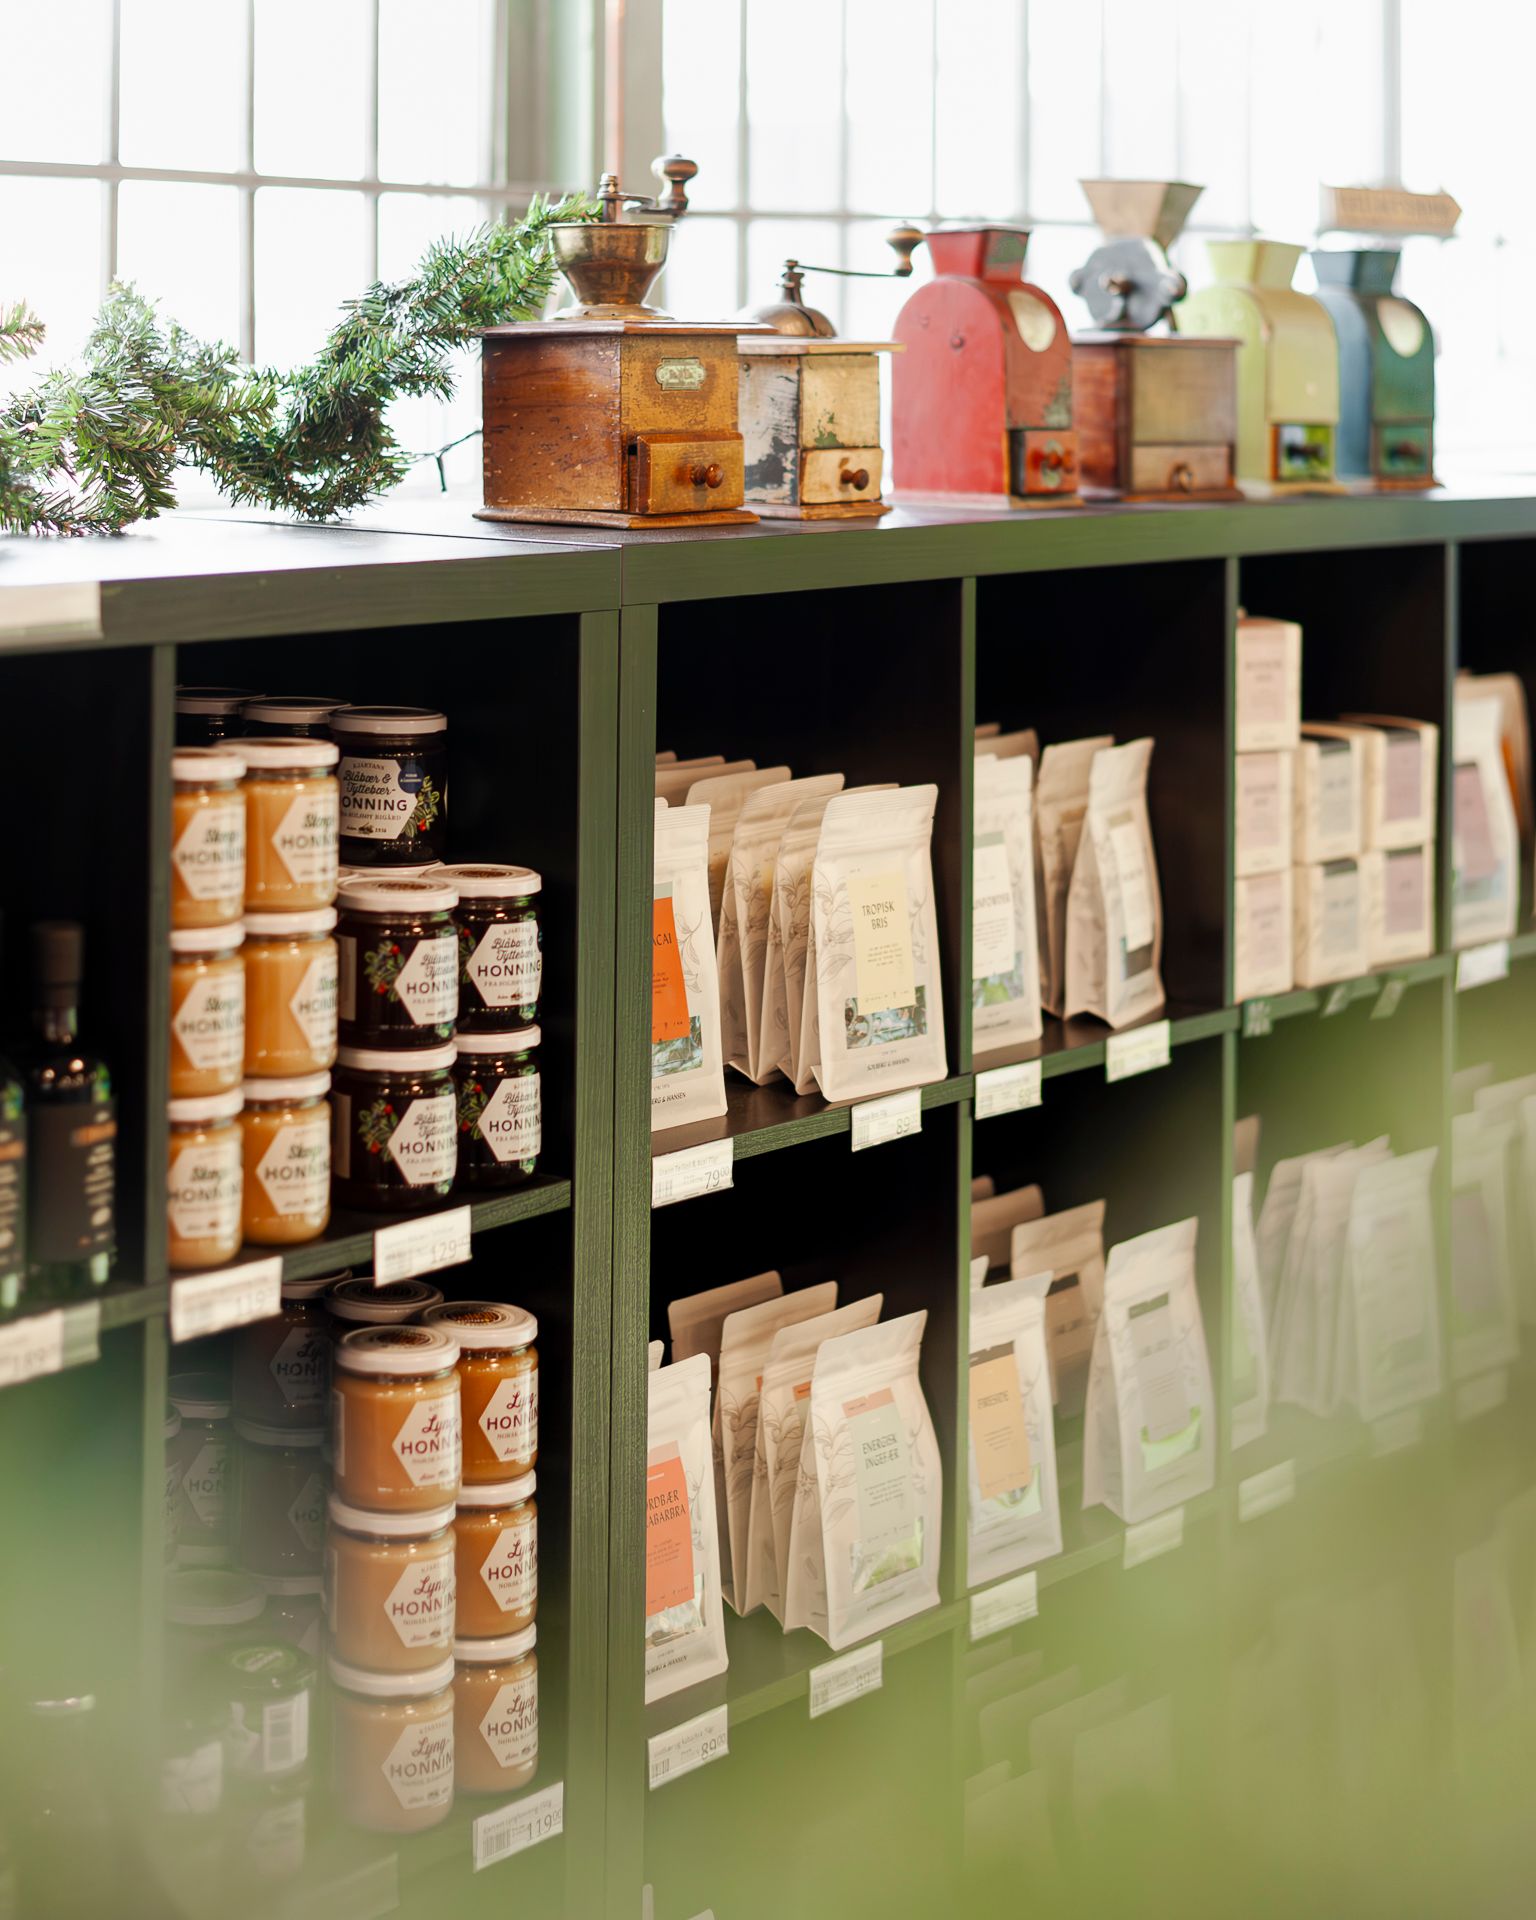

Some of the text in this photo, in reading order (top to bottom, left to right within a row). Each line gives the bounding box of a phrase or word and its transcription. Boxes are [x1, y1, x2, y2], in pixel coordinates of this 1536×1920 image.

[382, 773, 392, 784] &
[342, 796, 408, 812] ONNING
[862, 901, 895, 917] TROPISK
[871, 917, 888, 929] BRIS
[477, 959, 541, 977] HONNING
[489, 1114, 540, 1132] HONNIN
[648, 1489, 679, 1511] RDBÆR
[647, 1504, 686, 1528] ABARBRA
[390, 1753, 452, 1779] HONNIN
